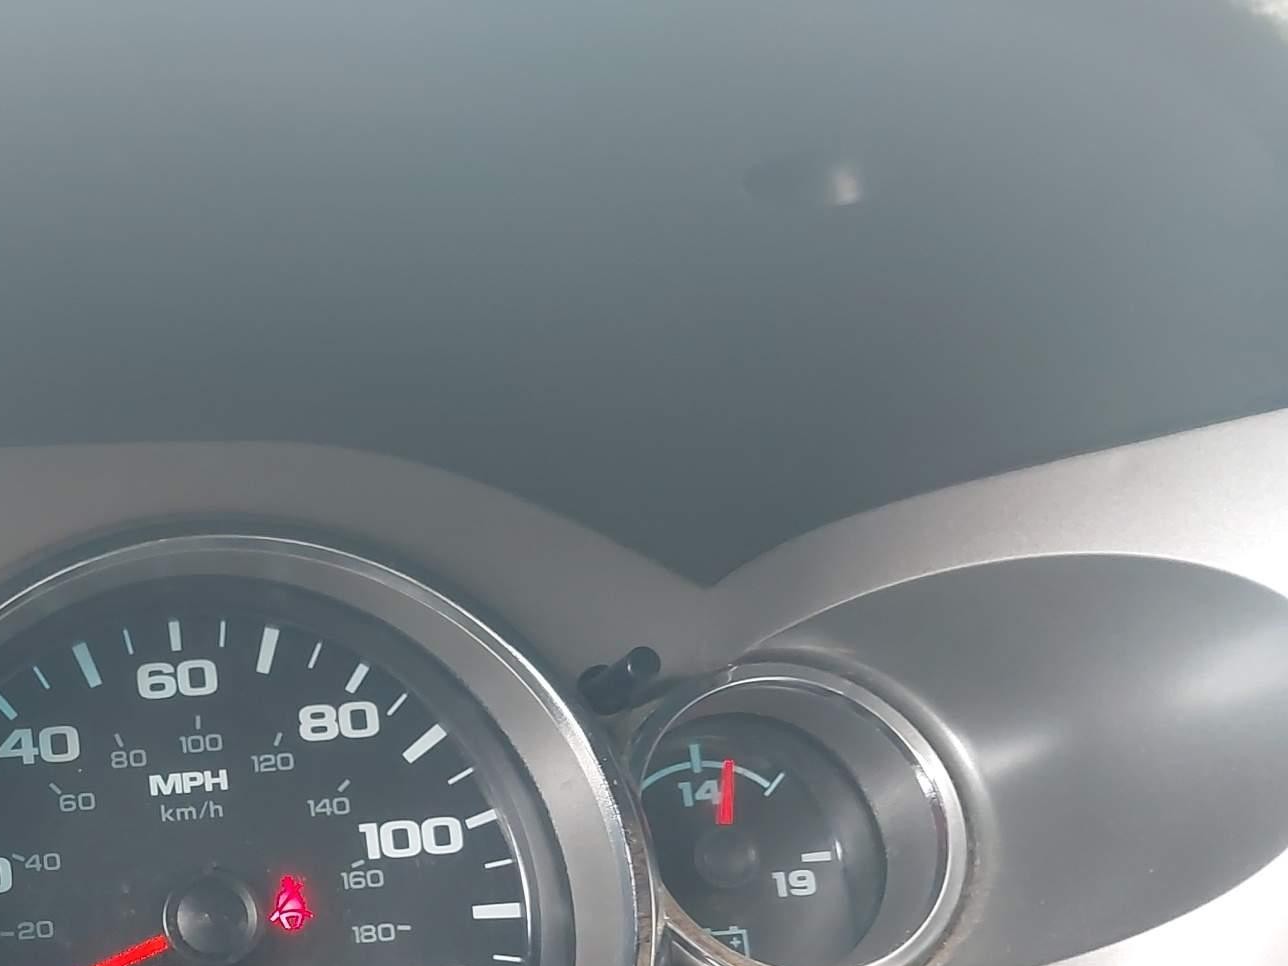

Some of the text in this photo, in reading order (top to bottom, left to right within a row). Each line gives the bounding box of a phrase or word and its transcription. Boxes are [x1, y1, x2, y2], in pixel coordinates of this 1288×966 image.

[137, 658, 219, 699] 60
[298, 701, 379, 742] 80
[179, 732, 223, 754] 100
[110, 748, 147, 768] 80
[251, 752, 295, 774] 120
[149, 769, 229, 796] MPH
[678, 780, 722, 807] 14
[59, 792, 96, 812] 60
[161, 801, 224, 822] km/h
[307, 795, 351, 817] 140
[359, 816, 464, 860] 100
[24, 852, 61, 872] 40
[341, 868, 385, 890] 160
[771, 871, 817, 897] 19
[17, 920, 54, 940] 20
[352, 924, 395, 944] 180
